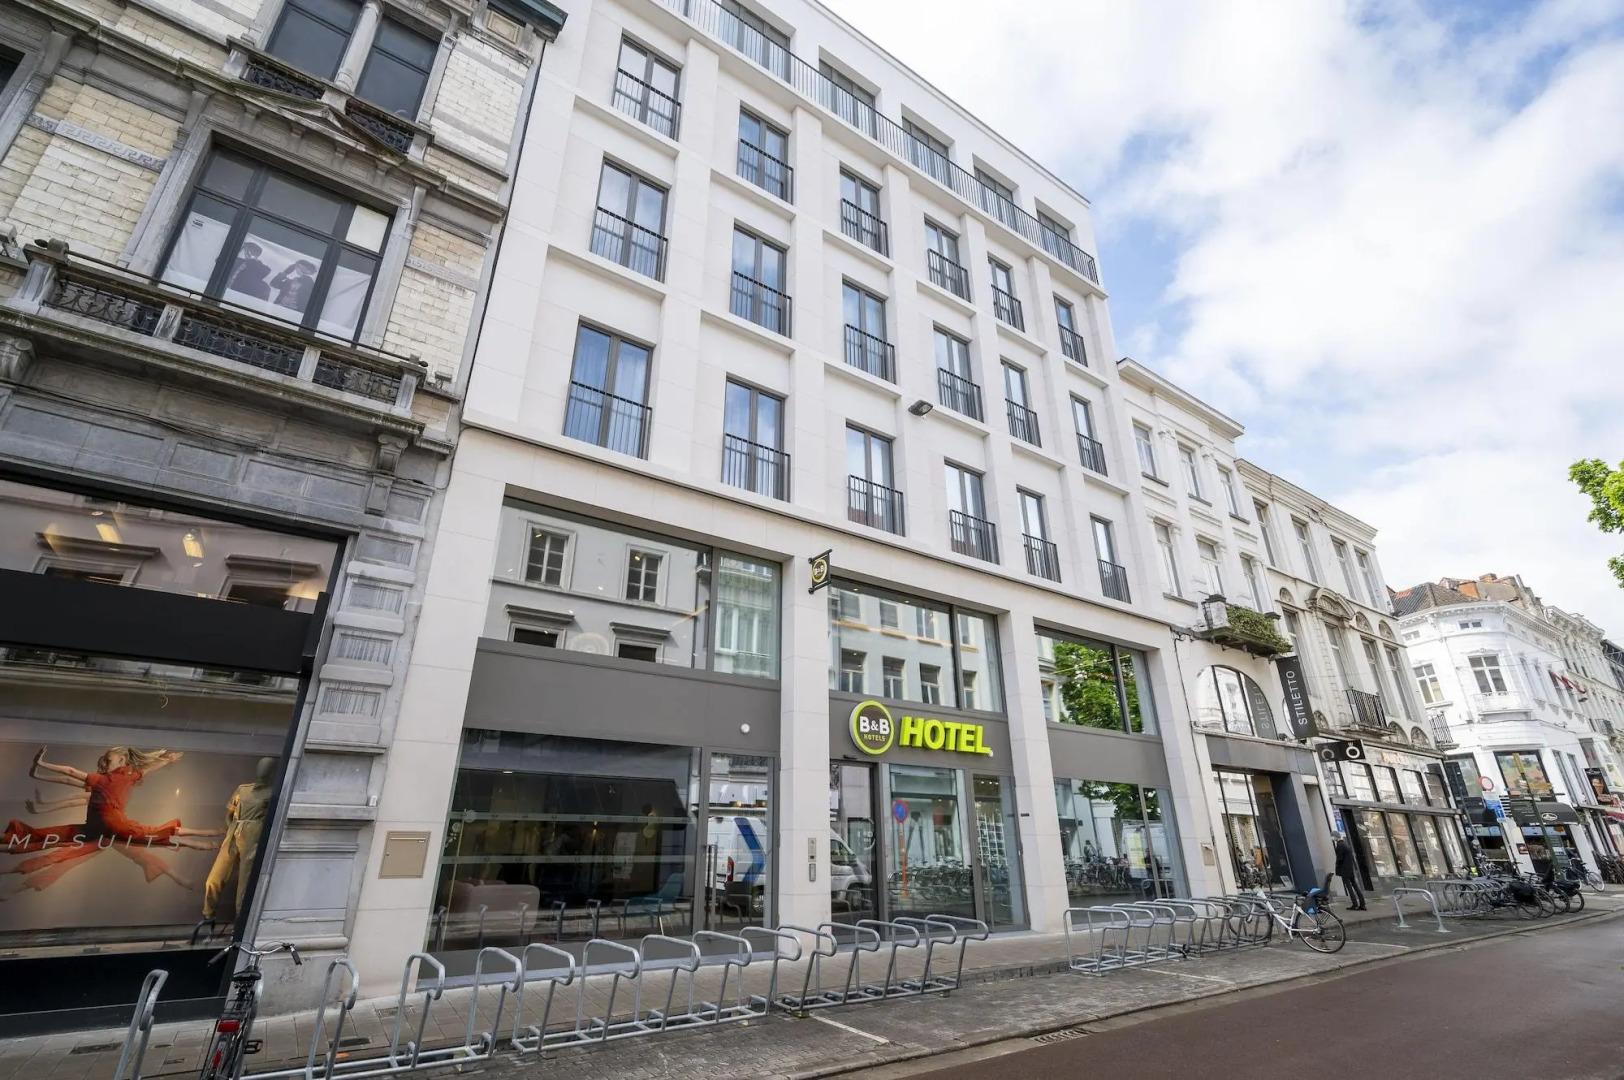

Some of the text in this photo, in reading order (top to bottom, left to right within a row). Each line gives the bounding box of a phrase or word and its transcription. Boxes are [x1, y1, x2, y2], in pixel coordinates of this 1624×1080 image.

[1286, 671, 1308, 725] STILETTO
[859, 715, 890, 735] B&B
[863, 733, 886, 742] HOTELS
[899, 716, 991, 754] HOTEL
